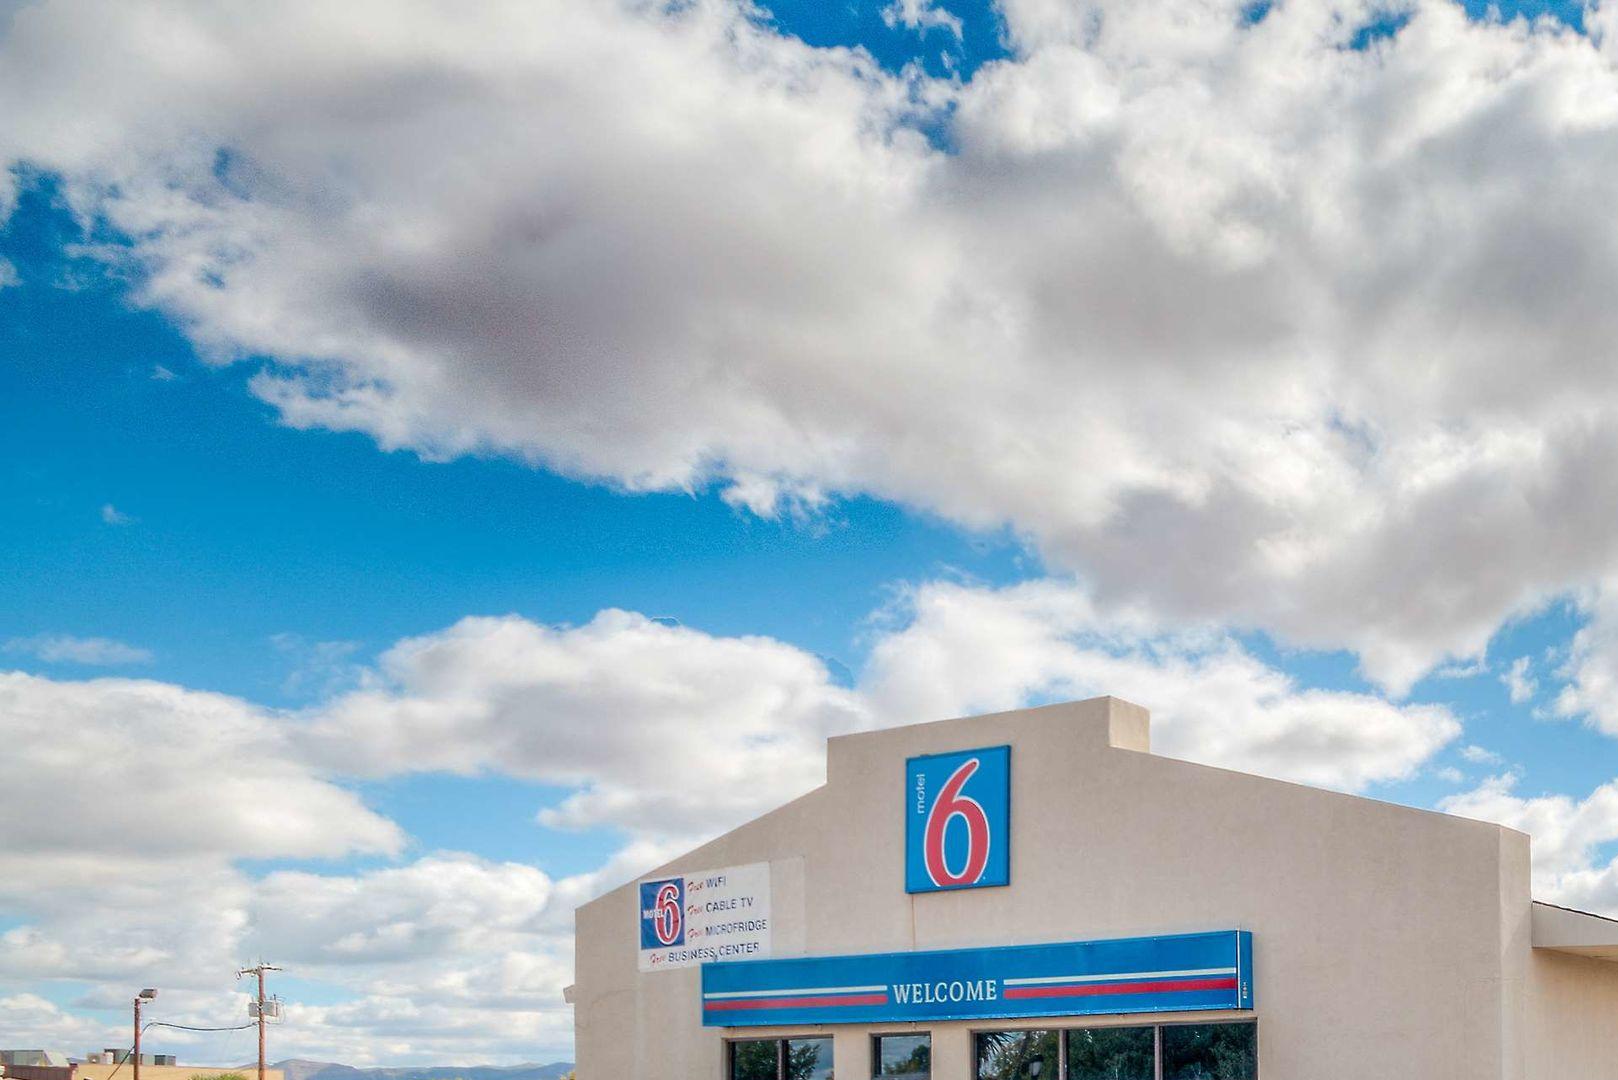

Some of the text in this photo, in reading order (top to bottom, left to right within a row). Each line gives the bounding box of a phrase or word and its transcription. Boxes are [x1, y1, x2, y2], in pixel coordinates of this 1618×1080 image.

[916, 757, 991, 887] motel 6
[655, 884, 681, 946] 6
[706, 898, 738, 913] CABLE
[740, 897, 754, 908] TV
[705, 919, 767, 937] MICROFRIDGE
[668, 946, 715, 962] BUSINESS
[718, 942, 759, 956] CENTER
[892, 979, 997, 1004] WELCOME
